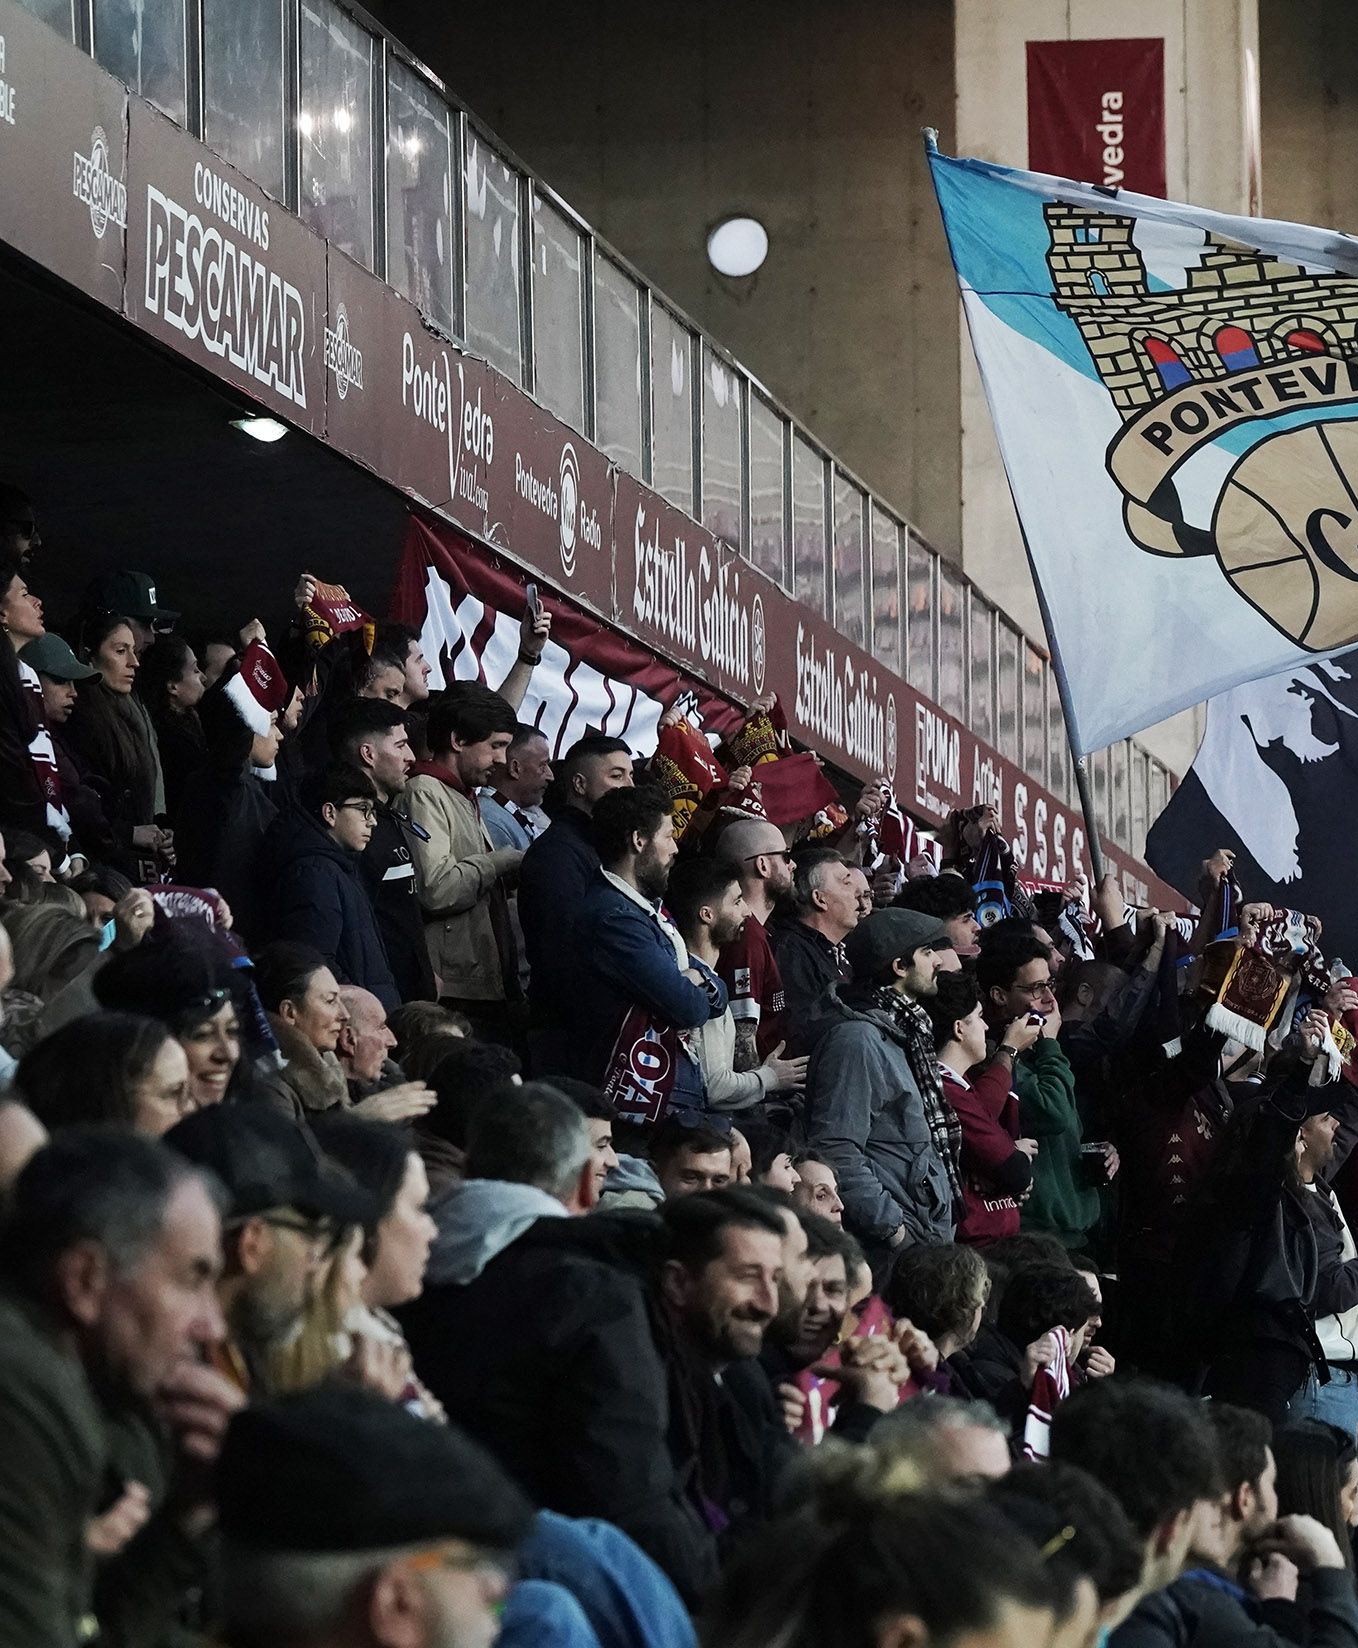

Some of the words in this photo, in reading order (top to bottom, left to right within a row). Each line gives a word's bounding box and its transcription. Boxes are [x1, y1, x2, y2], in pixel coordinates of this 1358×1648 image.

[1096, 91, 1125, 190] vedra
[73, 151, 128, 229] PESCAMAR
[194, 162, 270, 251] CONSERVAS
[145, 184, 307, 409] PESCAMAR
[323, 326, 363, 390] PESCAMAR
[515, 452, 558, 520] Pontevedra
[580, 500, 601, 551] Radio
[633, 503, 696, 652] Estrella
[699, 546, 749, 686] Galicia
[795, 621, 843, 748] Estrella
[844, 655, 884, 774] Galicia
